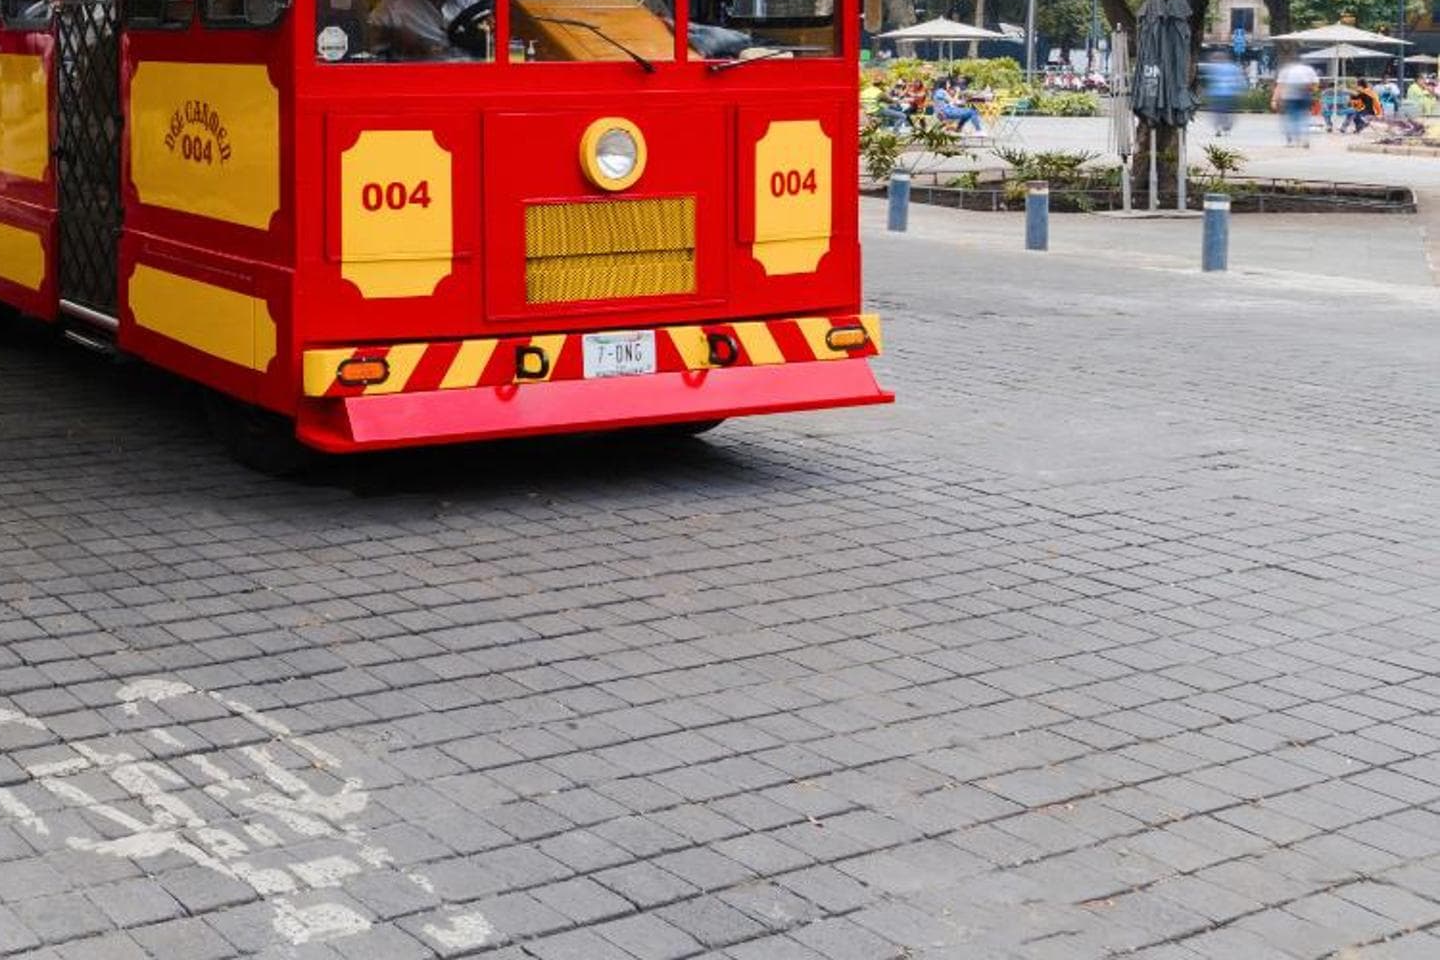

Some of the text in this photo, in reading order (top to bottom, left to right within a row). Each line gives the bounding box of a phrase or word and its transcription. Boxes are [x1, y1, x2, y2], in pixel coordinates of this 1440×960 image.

[182, 134, 212, 165] 004
[362, 180, 431, 211] 004
[770, 168, 817, 198] 004
